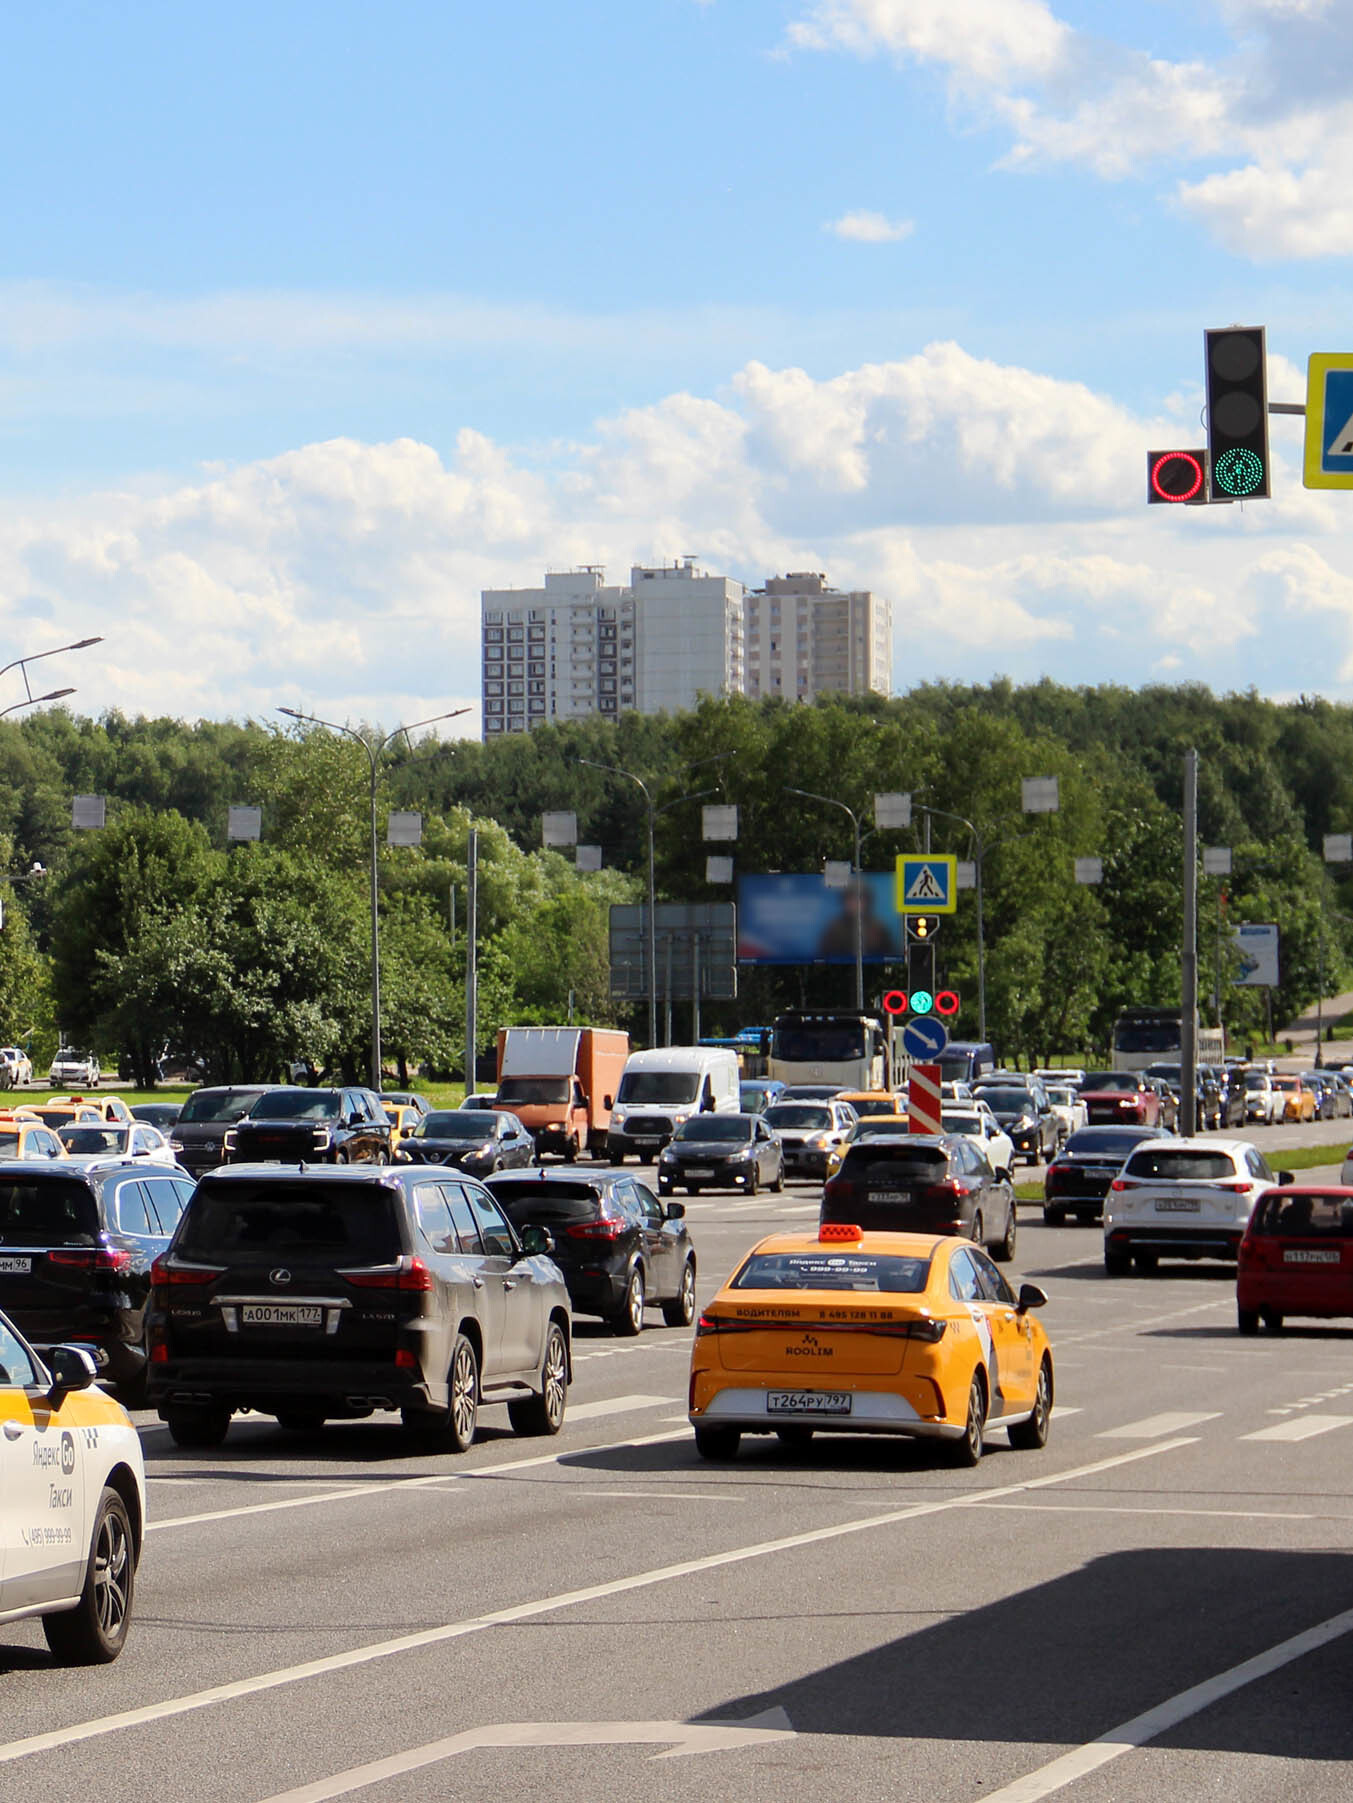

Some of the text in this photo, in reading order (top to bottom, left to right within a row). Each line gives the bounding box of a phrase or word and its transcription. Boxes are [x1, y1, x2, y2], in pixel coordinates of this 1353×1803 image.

[15, 1258, 27, 1269] 96
[247, 1308, 318, 1321] А001МК 177
[772, 1395, 847, 1407] Т264РУ 797
[32, 1437, 73, 1469] Яндекс Go
[49, 1483, 72, 1508] Такси
[29, 1527, 72, 1546] (495) 999-99-99
